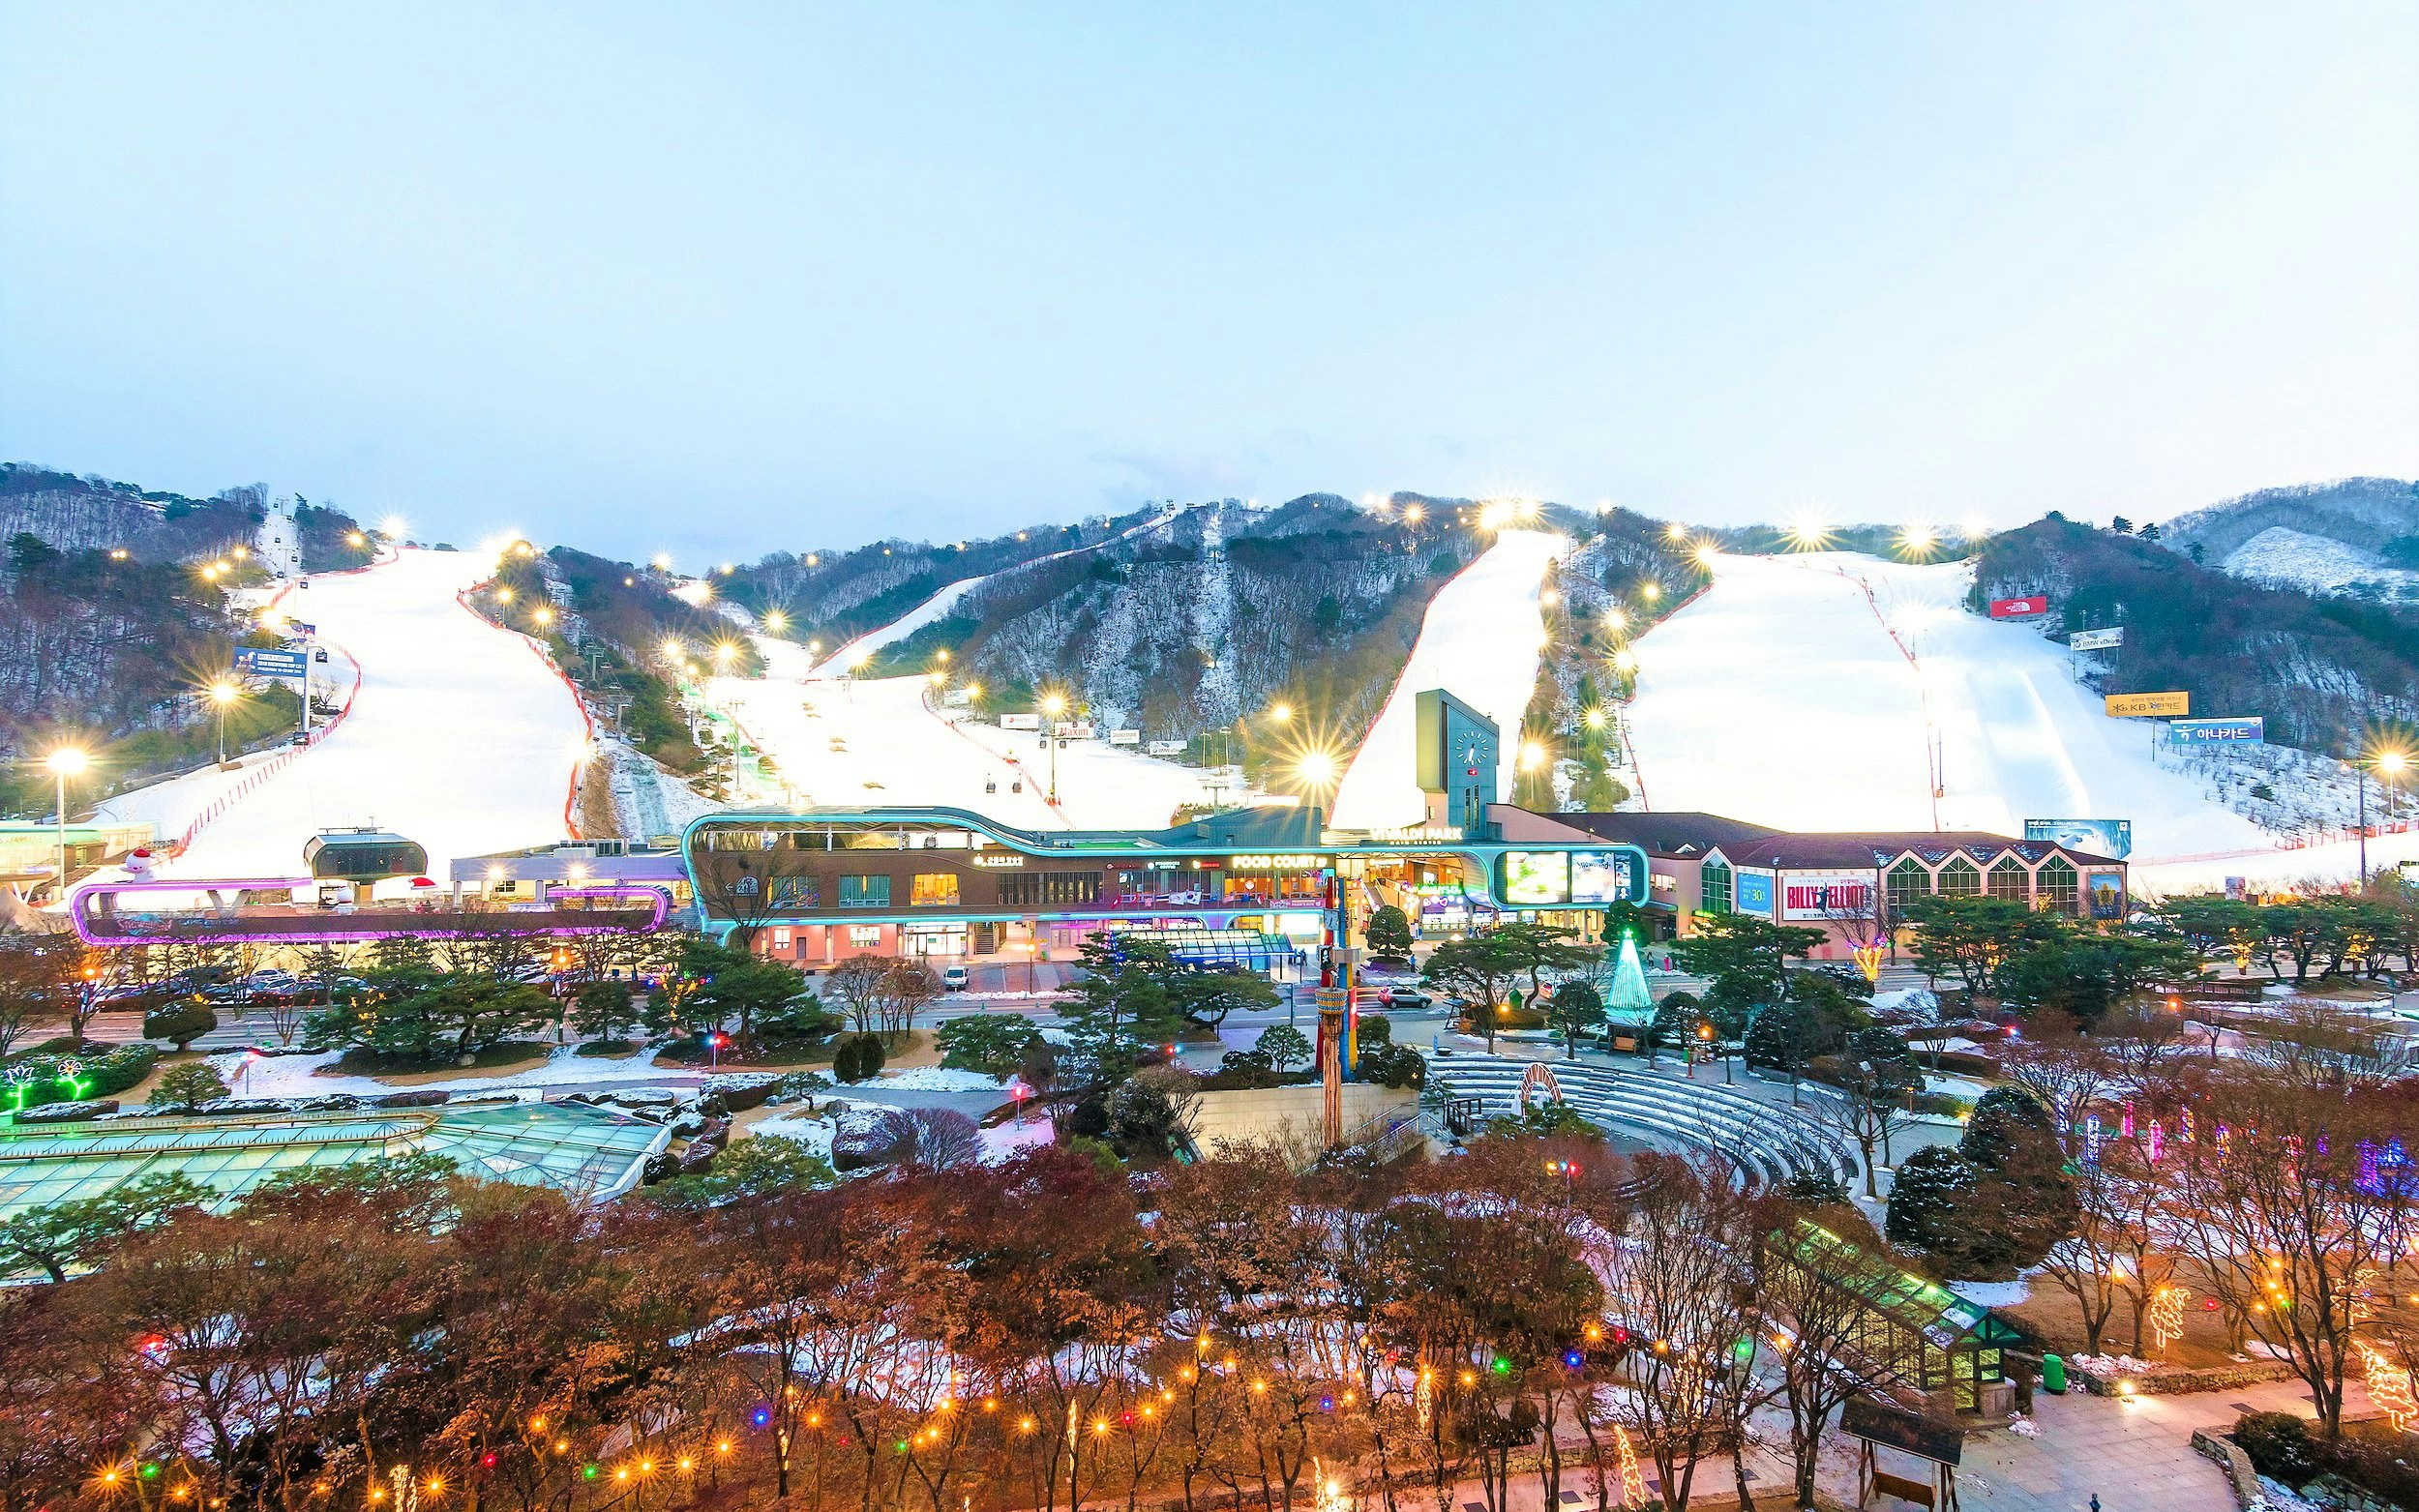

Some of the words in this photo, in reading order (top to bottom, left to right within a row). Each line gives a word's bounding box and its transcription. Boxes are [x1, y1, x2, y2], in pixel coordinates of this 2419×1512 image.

[2130, 703, 2147, 712] KB
[2149, 701, 2182, 711] 민카드
[1060, 726, 1089, 736] Maxim
[2196, 727, 2251, 741] 하나카드
[1369, 827, 1425, 841] VIVALDI
[1425, 827, 1464, 841] PARK
[1233, 856, 1272, 869] FOOD
[1272, 856, 1316, 869] COURT
[1787, 885, 1819, 909] BILLY
[1827, 885, 1866, 909] ELLIOT
